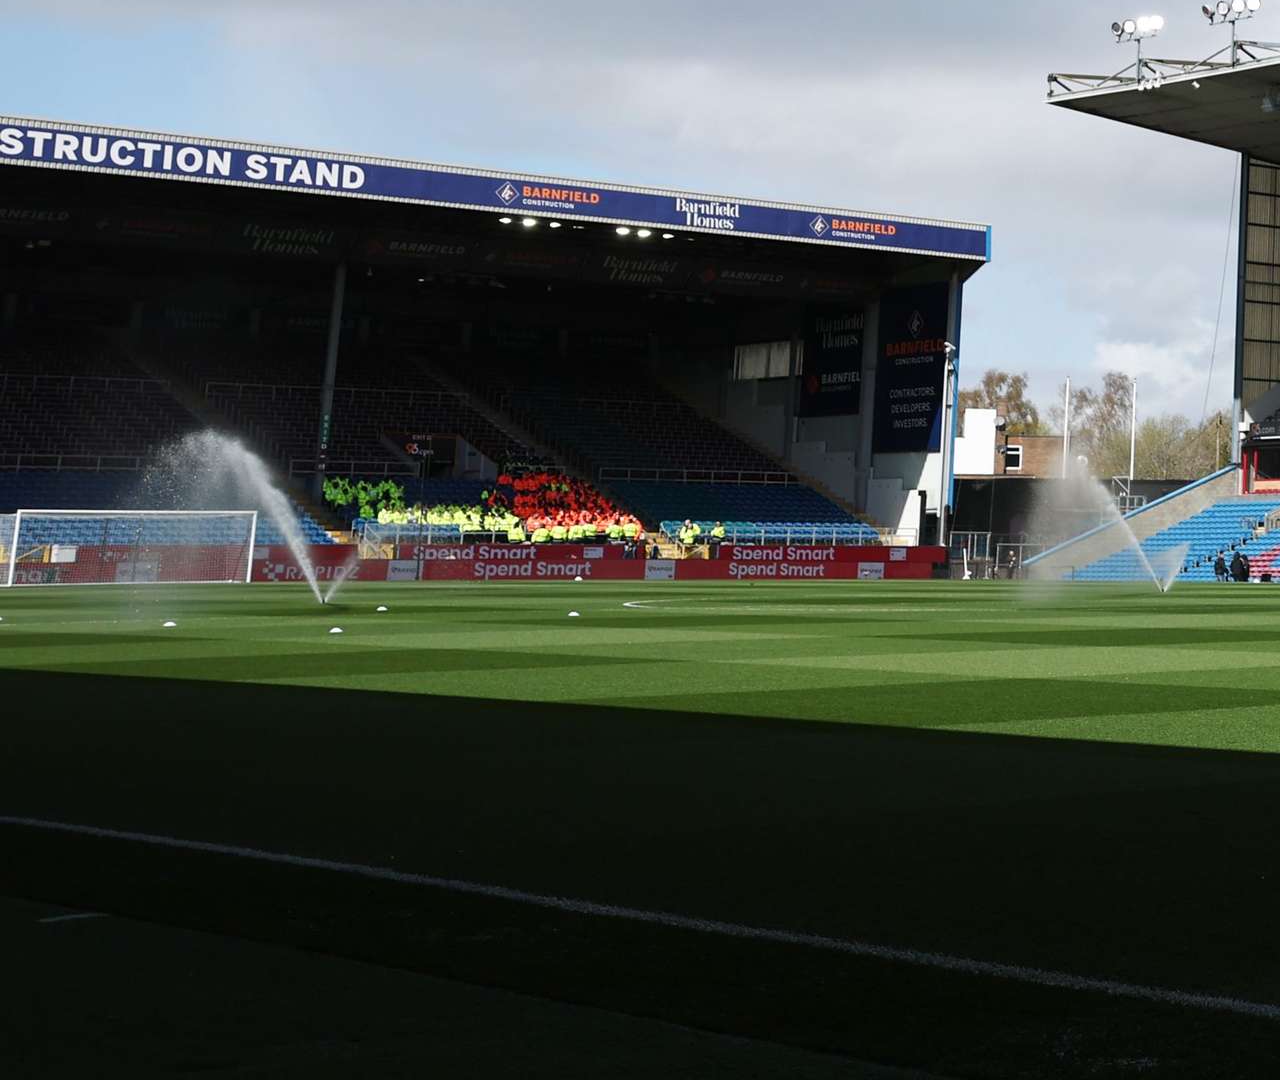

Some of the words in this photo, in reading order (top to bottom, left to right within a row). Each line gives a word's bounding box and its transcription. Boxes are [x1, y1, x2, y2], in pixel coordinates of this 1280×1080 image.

[0, 127, 232, 176] STRUCTION
[245, 153, 365, 189] STAND
[522, 185, 600, 204] BARNFIELD
[522, 198, 575, 209] CONSTRUCTION
[675, 197, 740, 219] Barnfield
[686, 213, 735, 230] Homes
[831, 219, 896, 236] BARNFIELD
[831, 231, 875, 240] CONSTRUCTION
[885, 338, 944, 357] BARNFIELD
[821, 370, 861, 385] BARNFIEL
[413, 545, 475, 559] Spend
[478, 545, 536, 559] Smart
[732, 546, 783, 560] Spend
[786, 546, 834, 560] Smart
[474, 561, 534, 580] Spend
[536, 561, 592, 576] Smart
[729, 562, 777, 580] Spend
[780, 562, 825, 576] Smart
